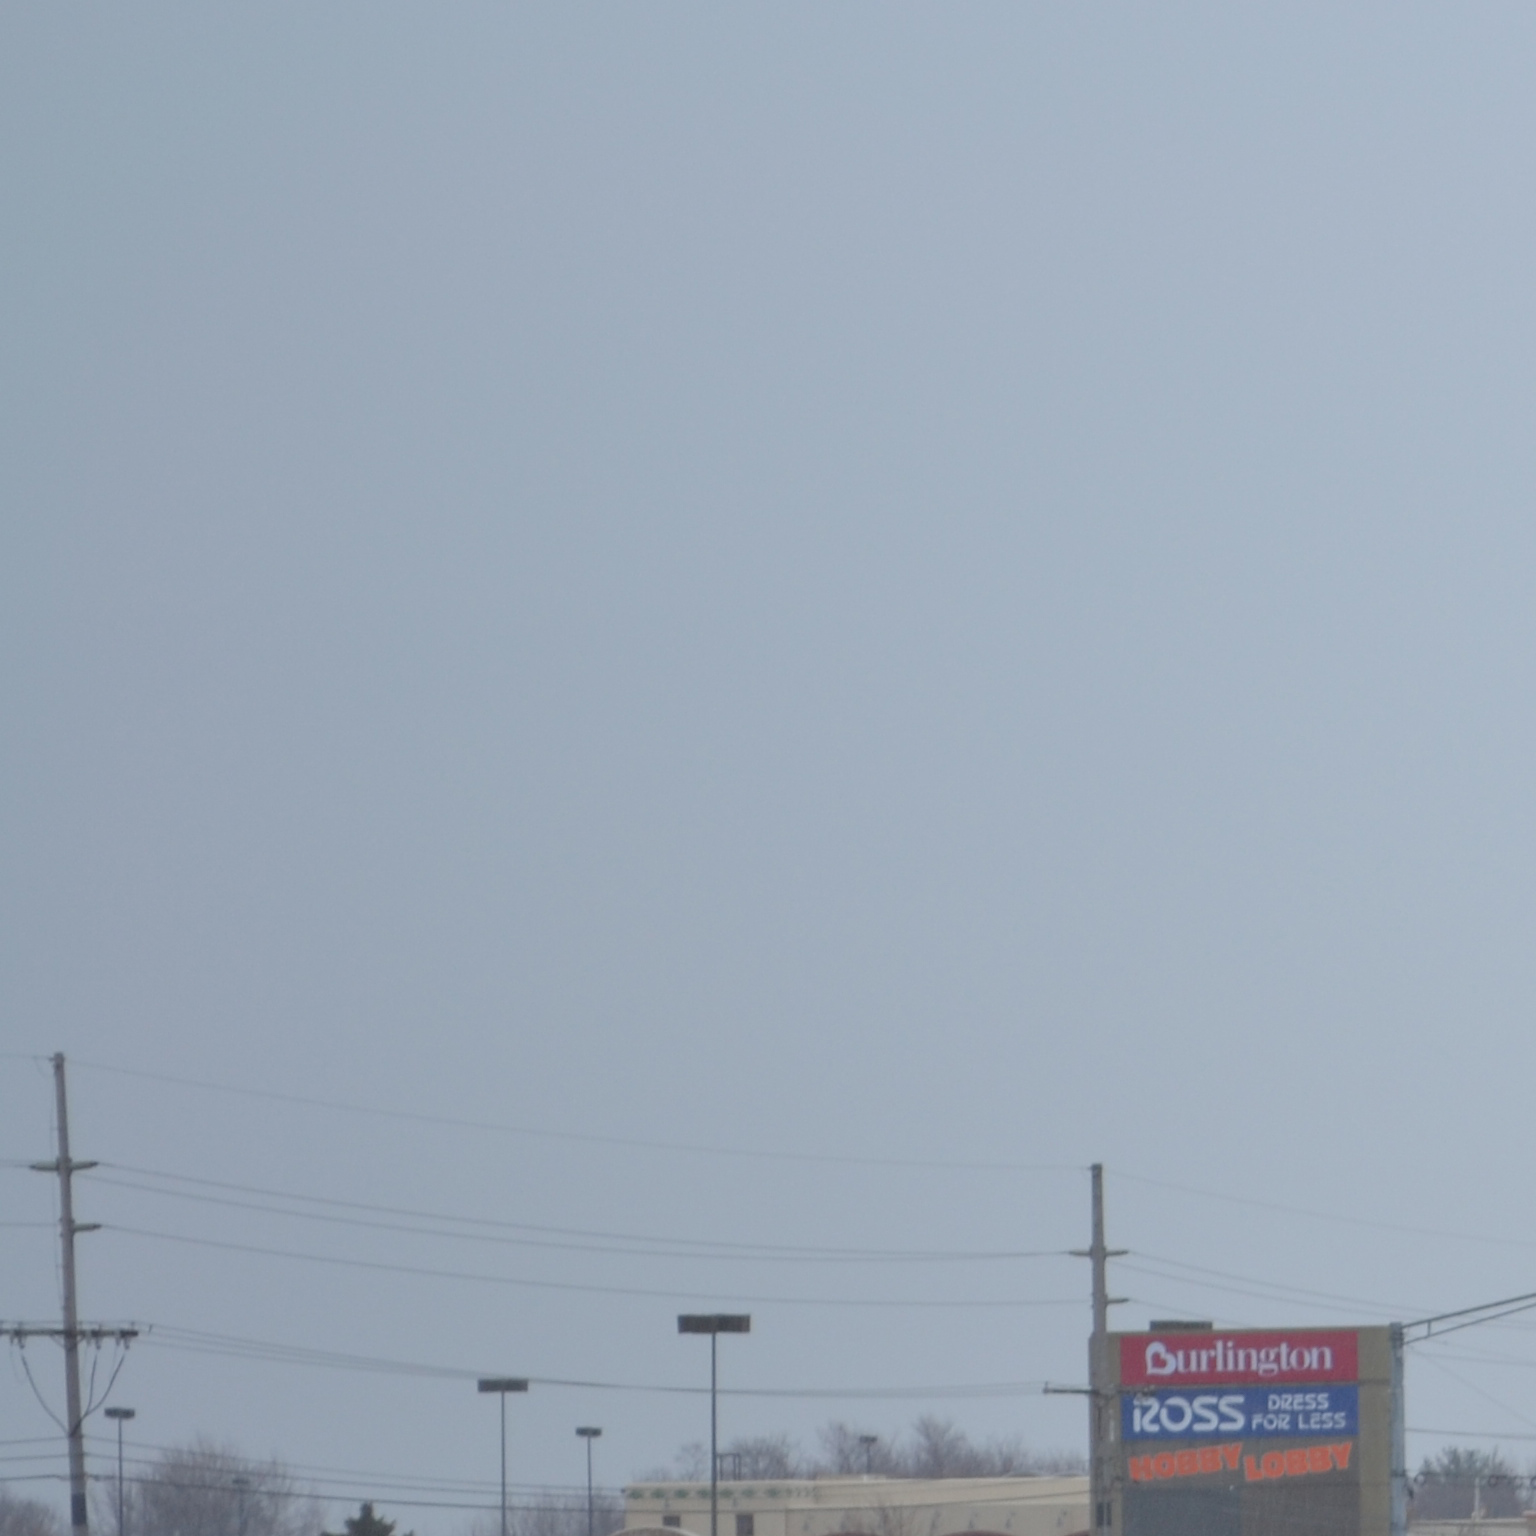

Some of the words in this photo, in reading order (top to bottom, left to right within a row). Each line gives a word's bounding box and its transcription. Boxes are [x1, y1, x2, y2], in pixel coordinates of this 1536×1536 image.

[1145, 1340, 1333, 1377] Burlington
[1132, 1395, 1246, 1433] ROSS
[1267, 1393, 1330, 1411] DRESS
[1252, 1413, 1291, 1430] FOR
[1298, 1412, 1346, 1429] LESS
[1128, 1442, 1243, 1482] HOBBY
[1244, 1442, 1352, 1482] LOBBY
